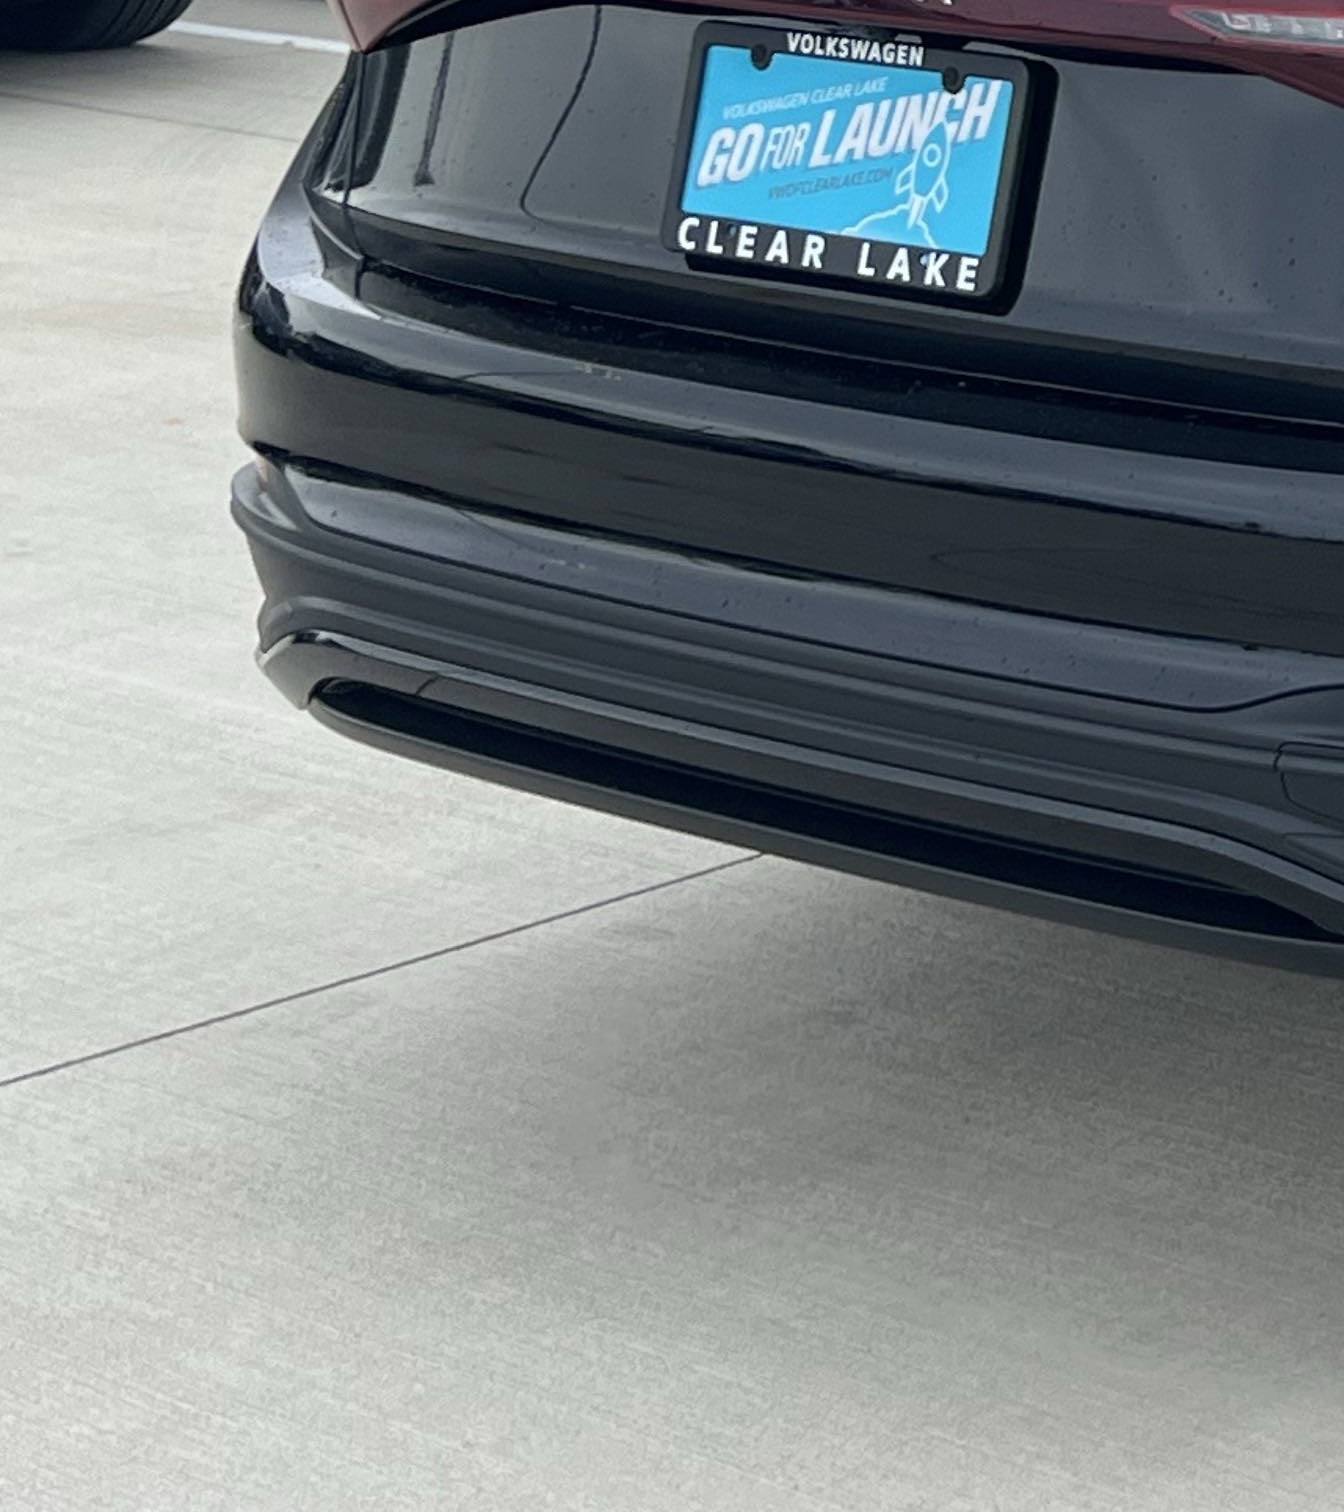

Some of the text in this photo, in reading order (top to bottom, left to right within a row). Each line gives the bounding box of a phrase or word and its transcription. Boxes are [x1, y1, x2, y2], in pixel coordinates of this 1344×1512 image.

[786, 32, 925, 67] VOLKSWAGEN
[723, 76, 889, 119] VOLKSWAGEN CLEAR LAKE
[697, 78, 1003, 189] GO FOR LAUNCH
[677, 216, 981, 292] CLEAR LAKE
